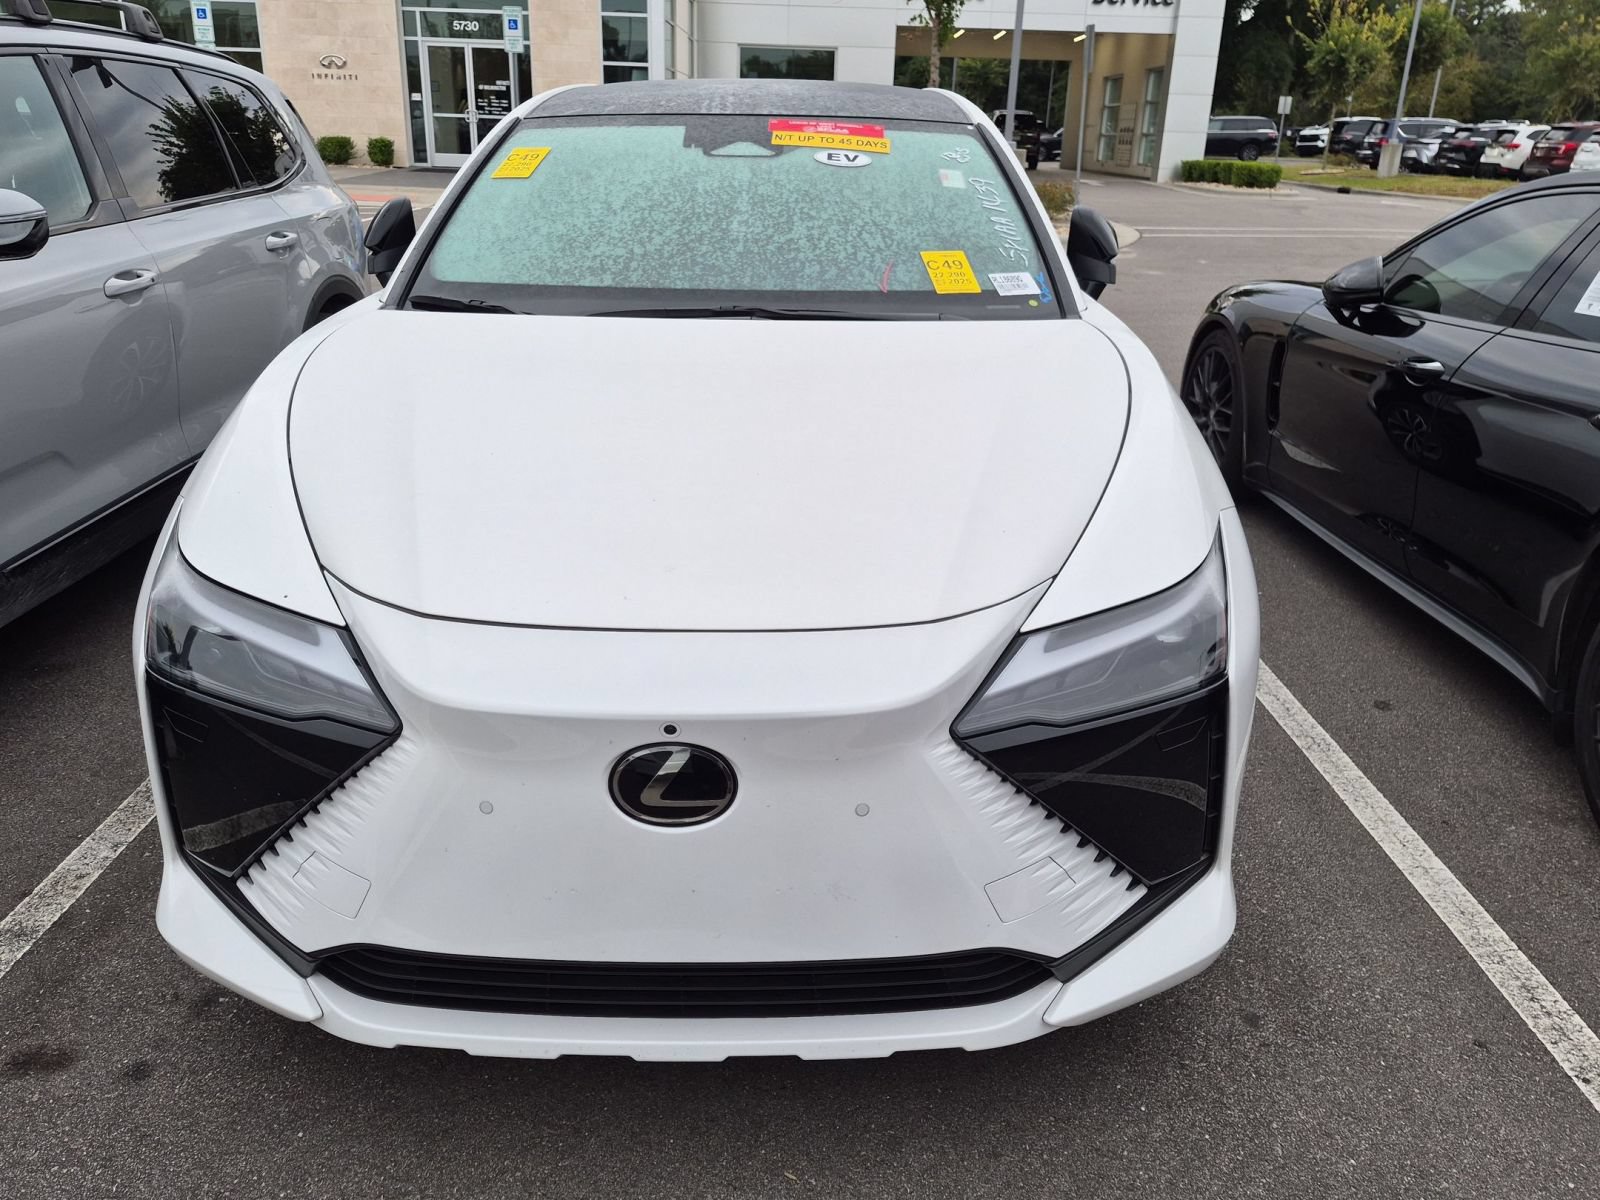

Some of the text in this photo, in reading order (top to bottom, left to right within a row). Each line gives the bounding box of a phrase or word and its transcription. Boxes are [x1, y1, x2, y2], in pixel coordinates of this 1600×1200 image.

[453, 20, 480, 32] 5730
[311, 72, 358, 81] INFINITI
[774, 133, 796, 142] N/T
[798, 135, 815, 143] UP
[820, 136, 836, 144] TO
[856, 139, 888, 149] DAYS
[827, 152, 860, 163] EV
